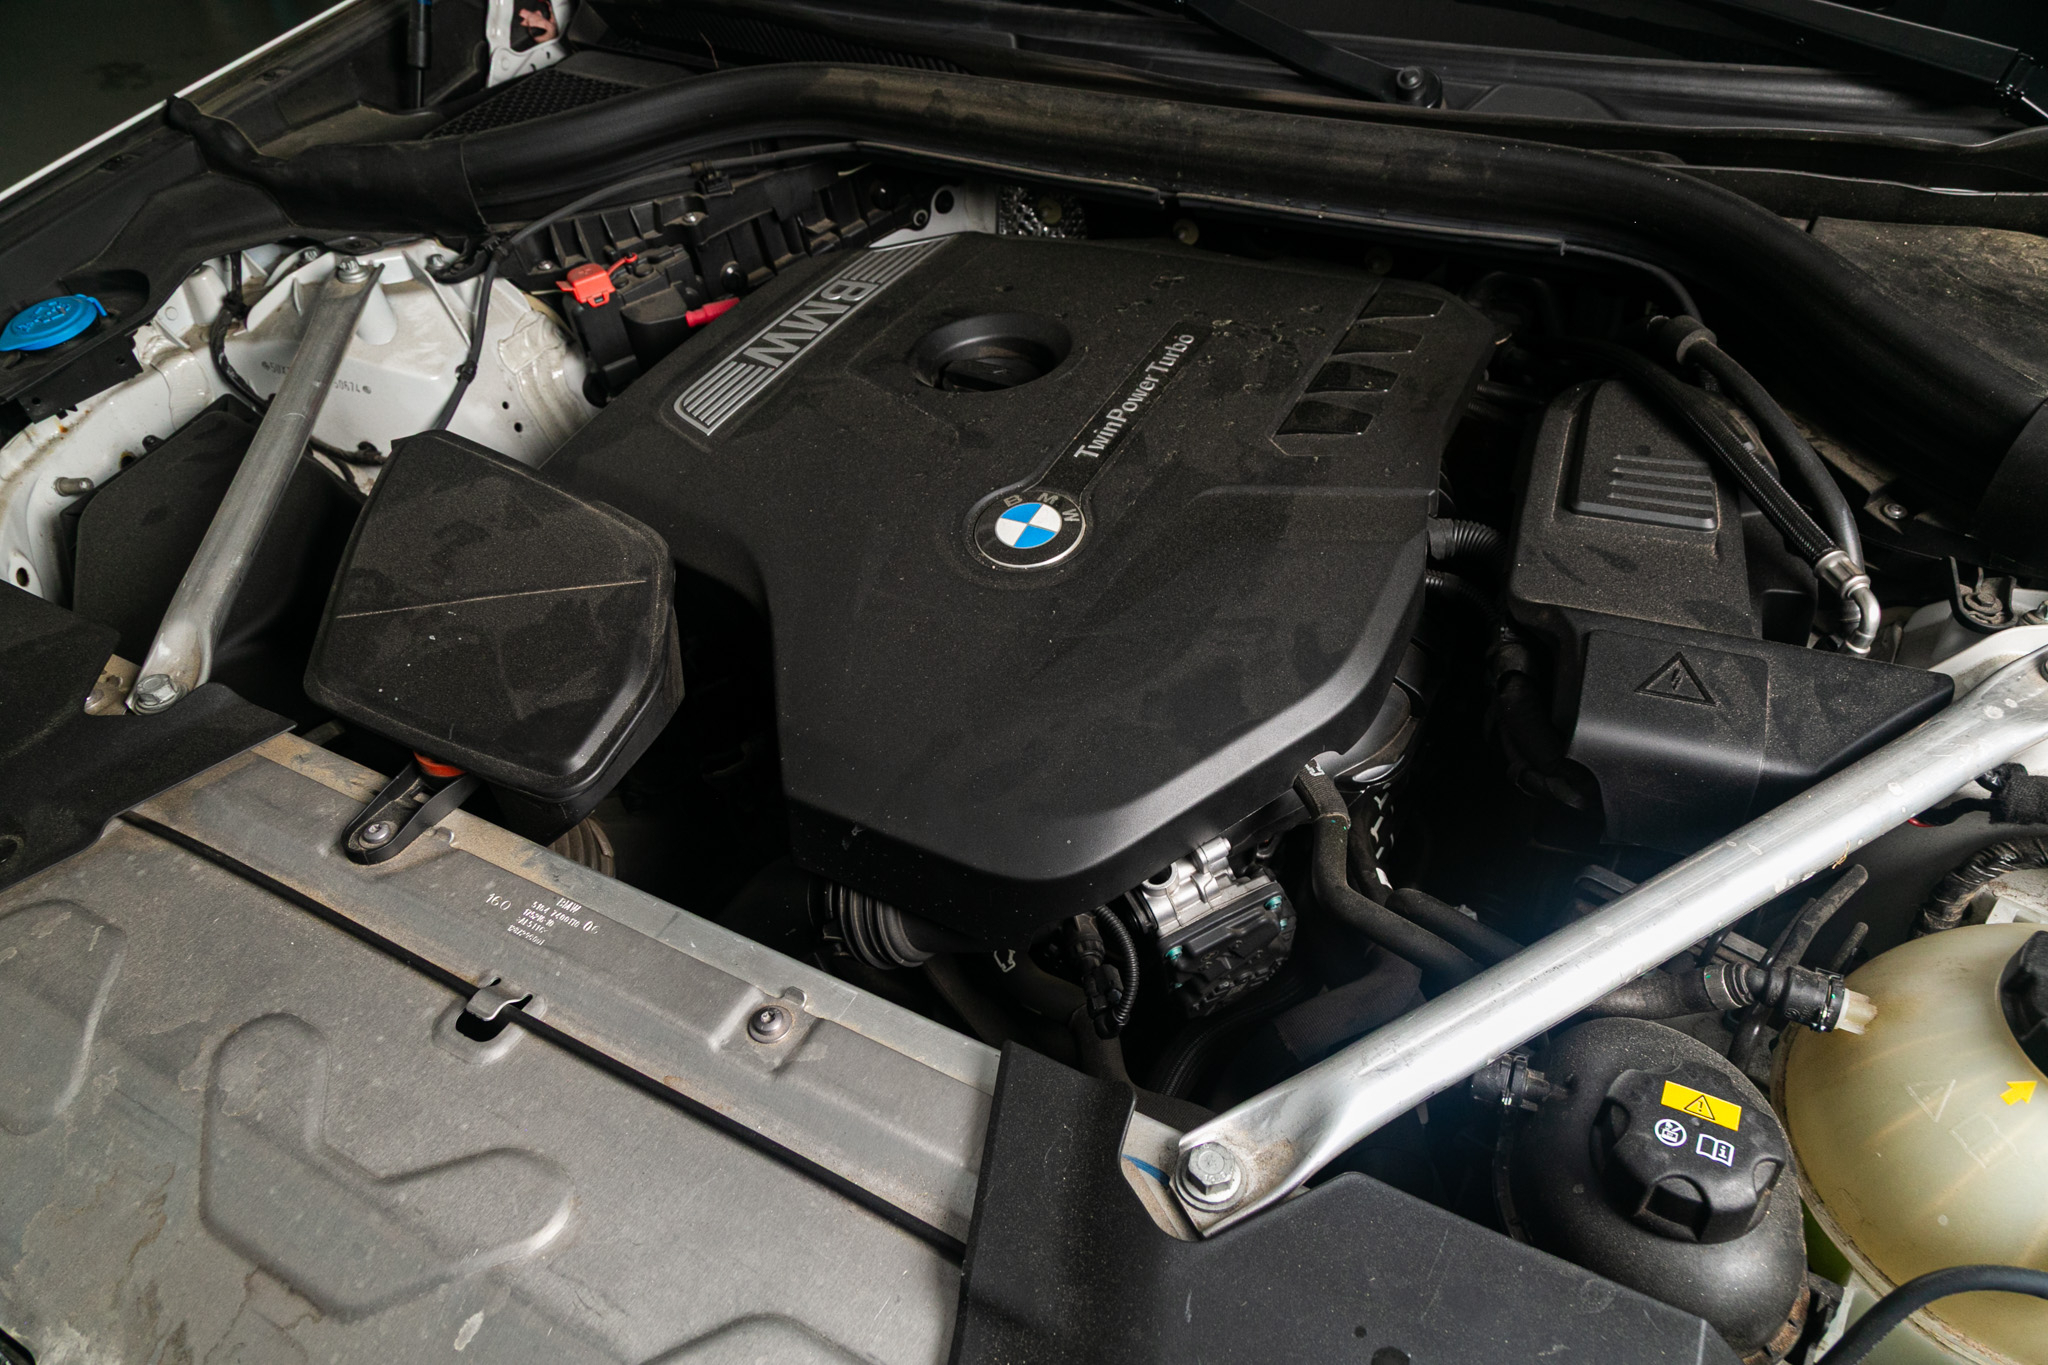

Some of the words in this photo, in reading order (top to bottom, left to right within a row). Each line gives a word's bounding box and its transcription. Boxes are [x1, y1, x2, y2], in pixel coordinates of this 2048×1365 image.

[743, 279, 880, 368] BMW
[1003, 492, 1080, 522] BMW
[556, 897, 582, 914] BMW
